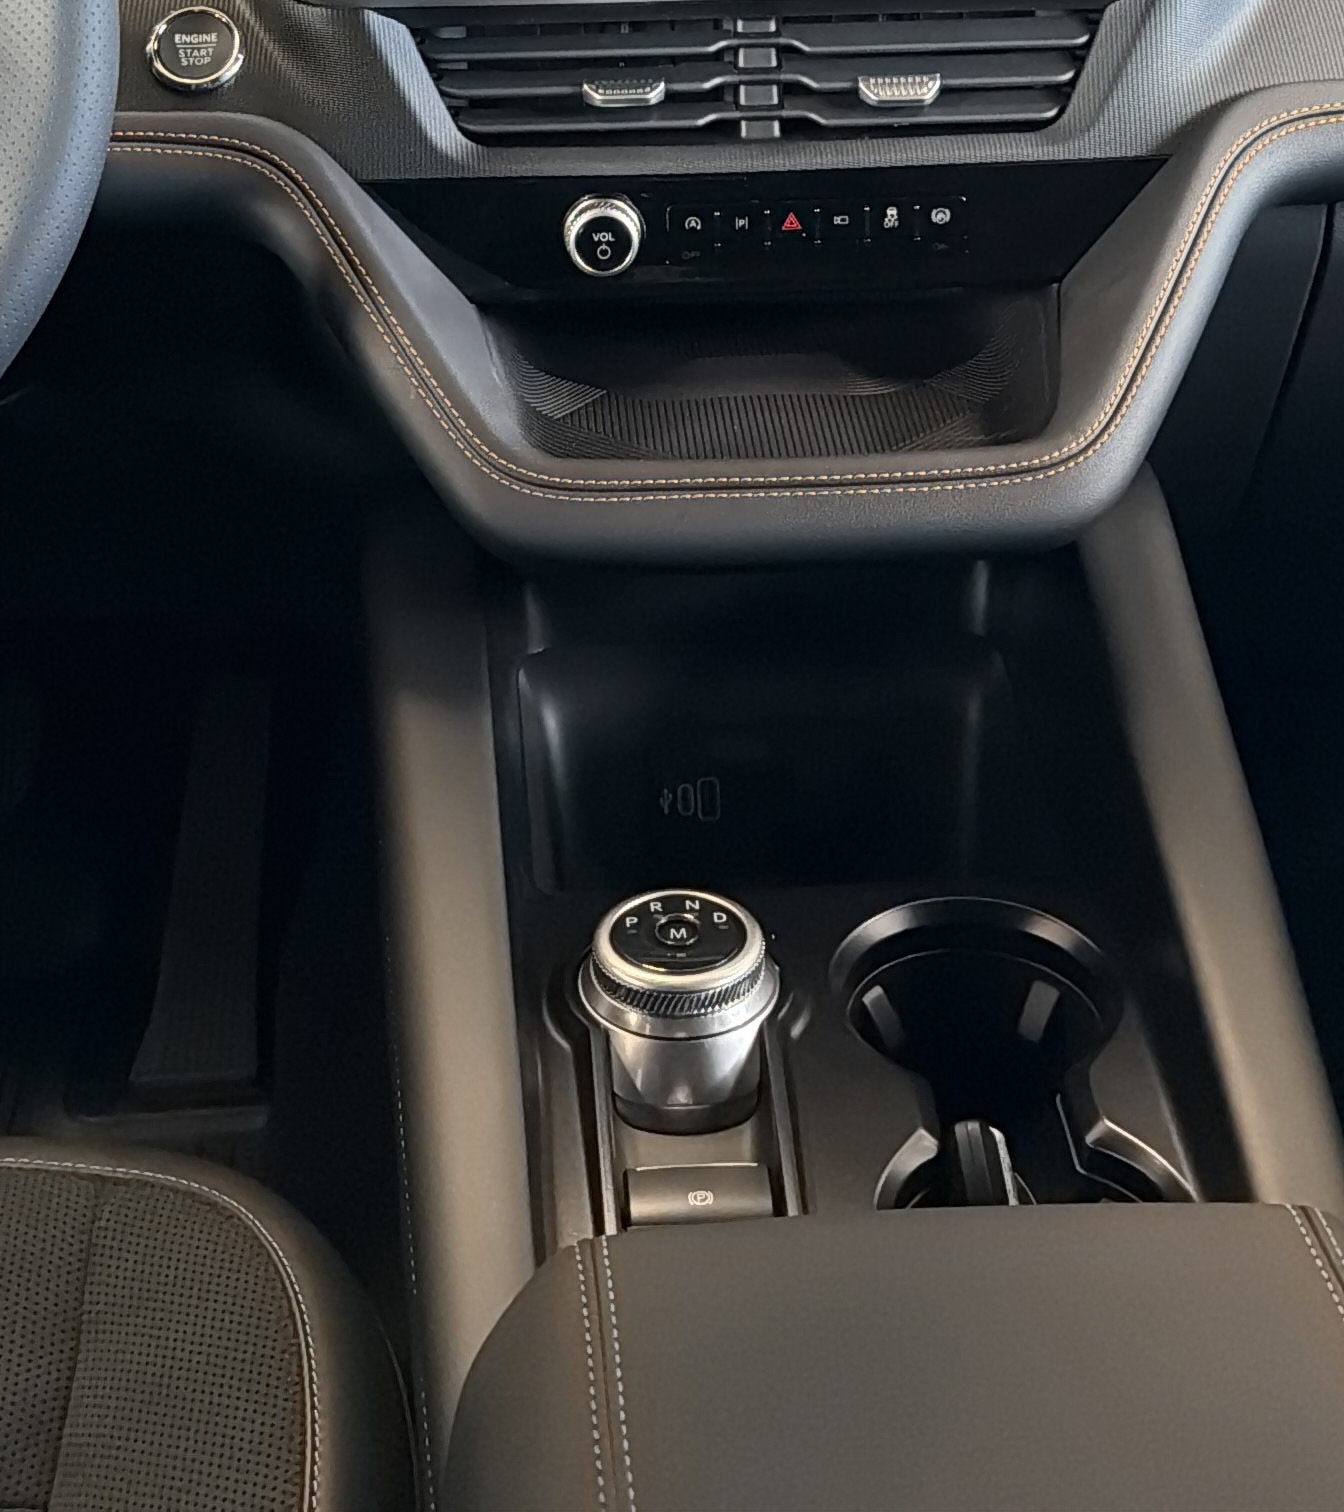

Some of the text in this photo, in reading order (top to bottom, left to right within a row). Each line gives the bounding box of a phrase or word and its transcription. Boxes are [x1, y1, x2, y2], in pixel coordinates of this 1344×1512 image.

[174, 32, 218, 44] ENGINE
[178, 48, 214, 58] START
[181, 57, 211, 66] STOP
[592, 232, 615, 242] VOL
[625, 899, 727, 927] P R N D
[670, 928, 687, 939] M
